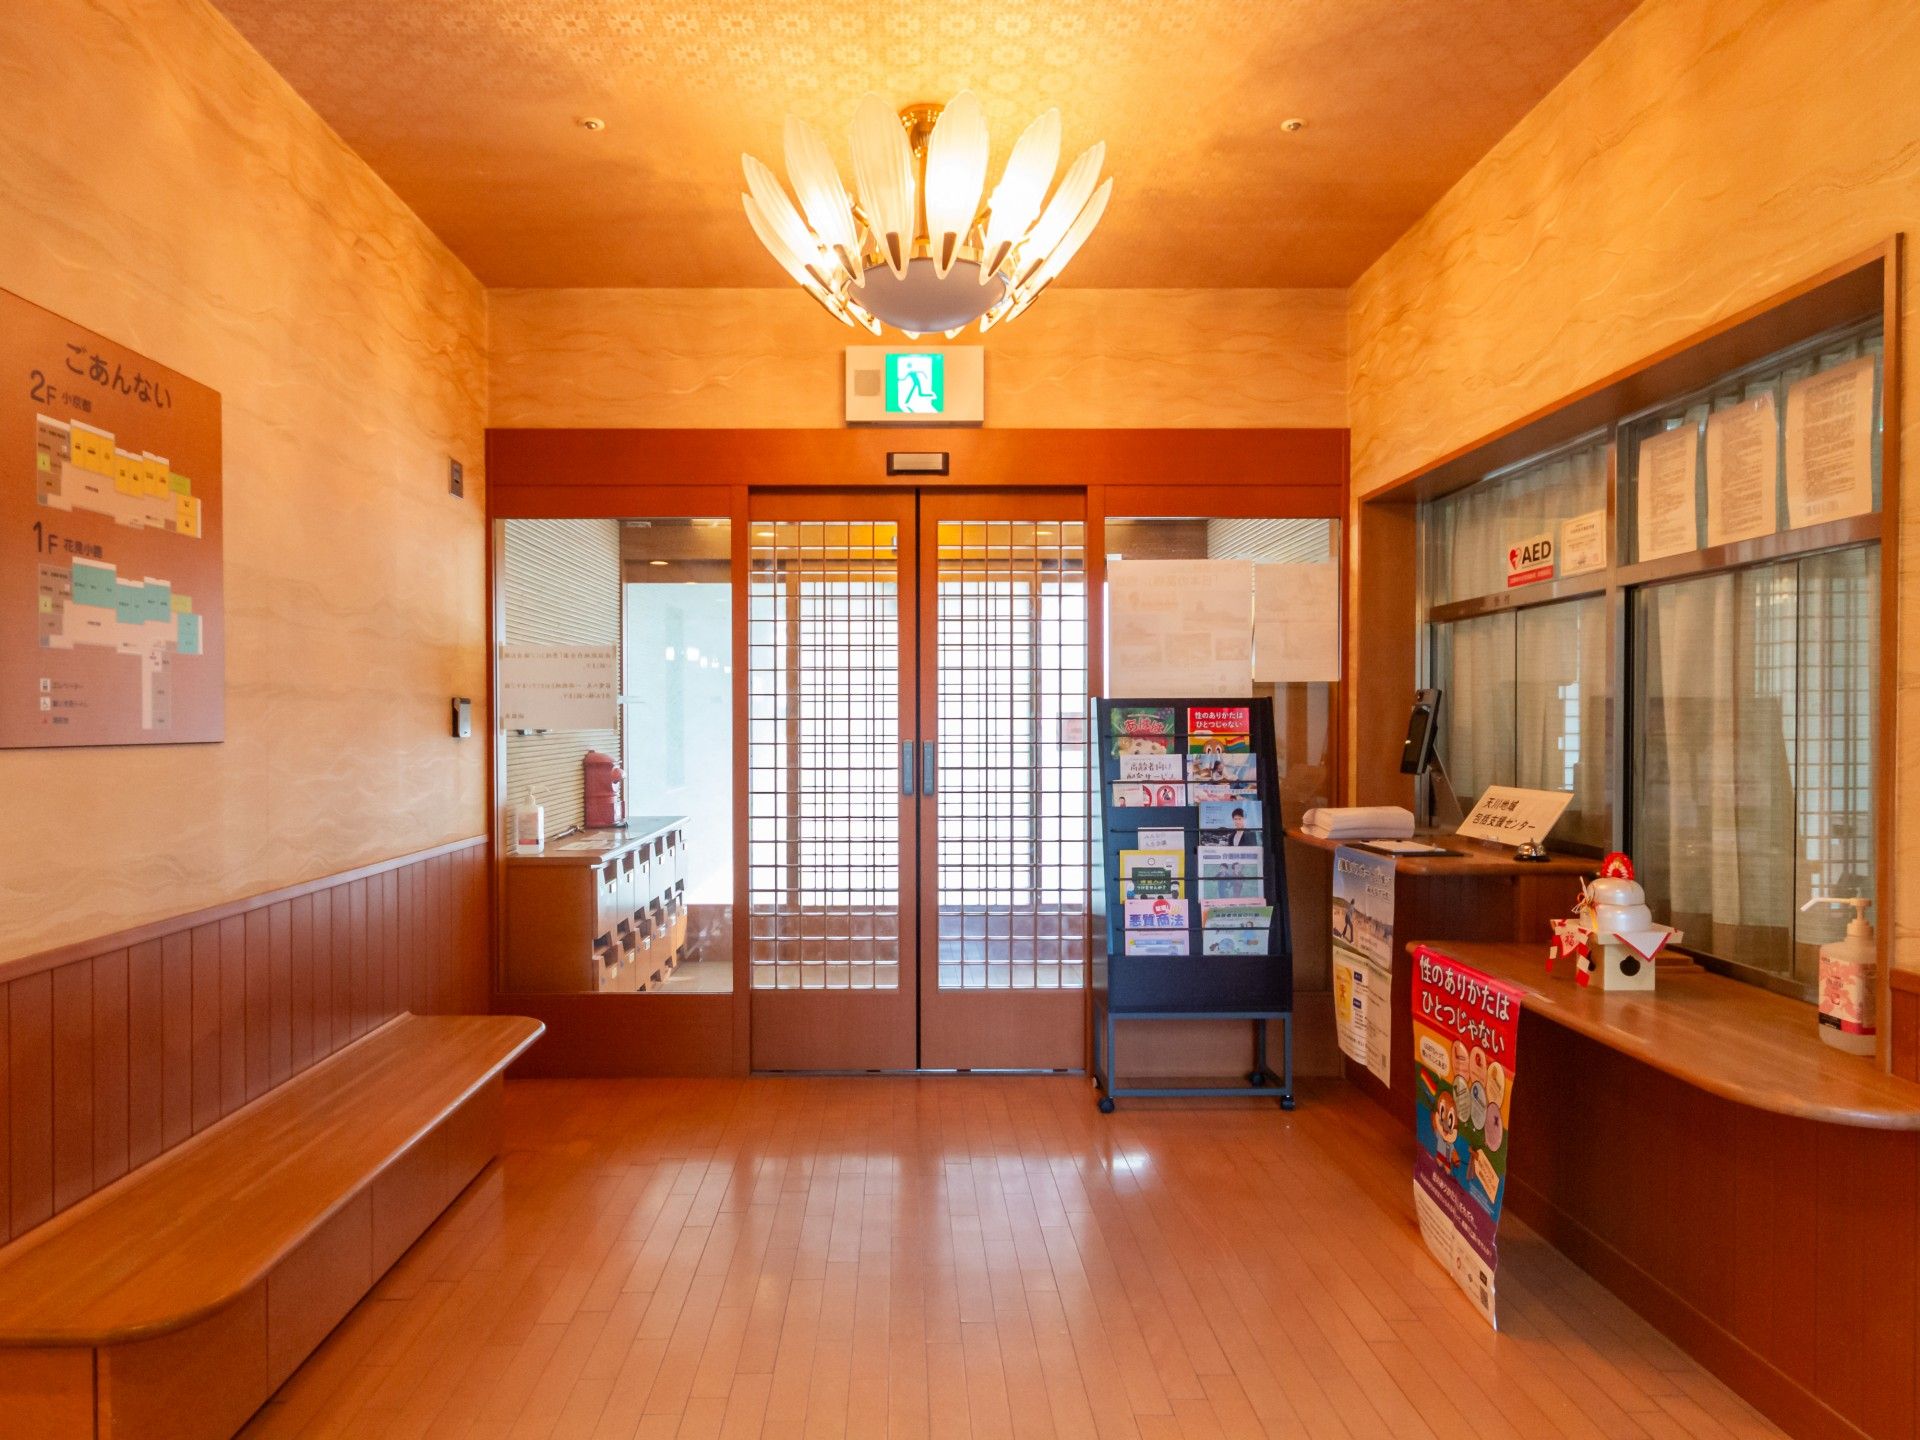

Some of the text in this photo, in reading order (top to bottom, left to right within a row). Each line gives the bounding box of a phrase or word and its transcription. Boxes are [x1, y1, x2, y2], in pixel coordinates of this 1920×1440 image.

[30, 369, 57, 405] 2F
[66, 343, 172, 409] ごあんない
[33, 520, 58, 554] 1F
[1521, 540, 1552, 565] AED
[1194, 711, 1243, 720] 性のありかたは
[1195, 720, 1243, 729] ひとつじゃない
[1472, 812, 1536, 831] 包括支援センター
[1129, 914, 1184, 927] 悪質商法
[1420, 954, 1510, 1021] 性のありかたは
[1422, 991, 1505, 1053] ひとつじゃない
